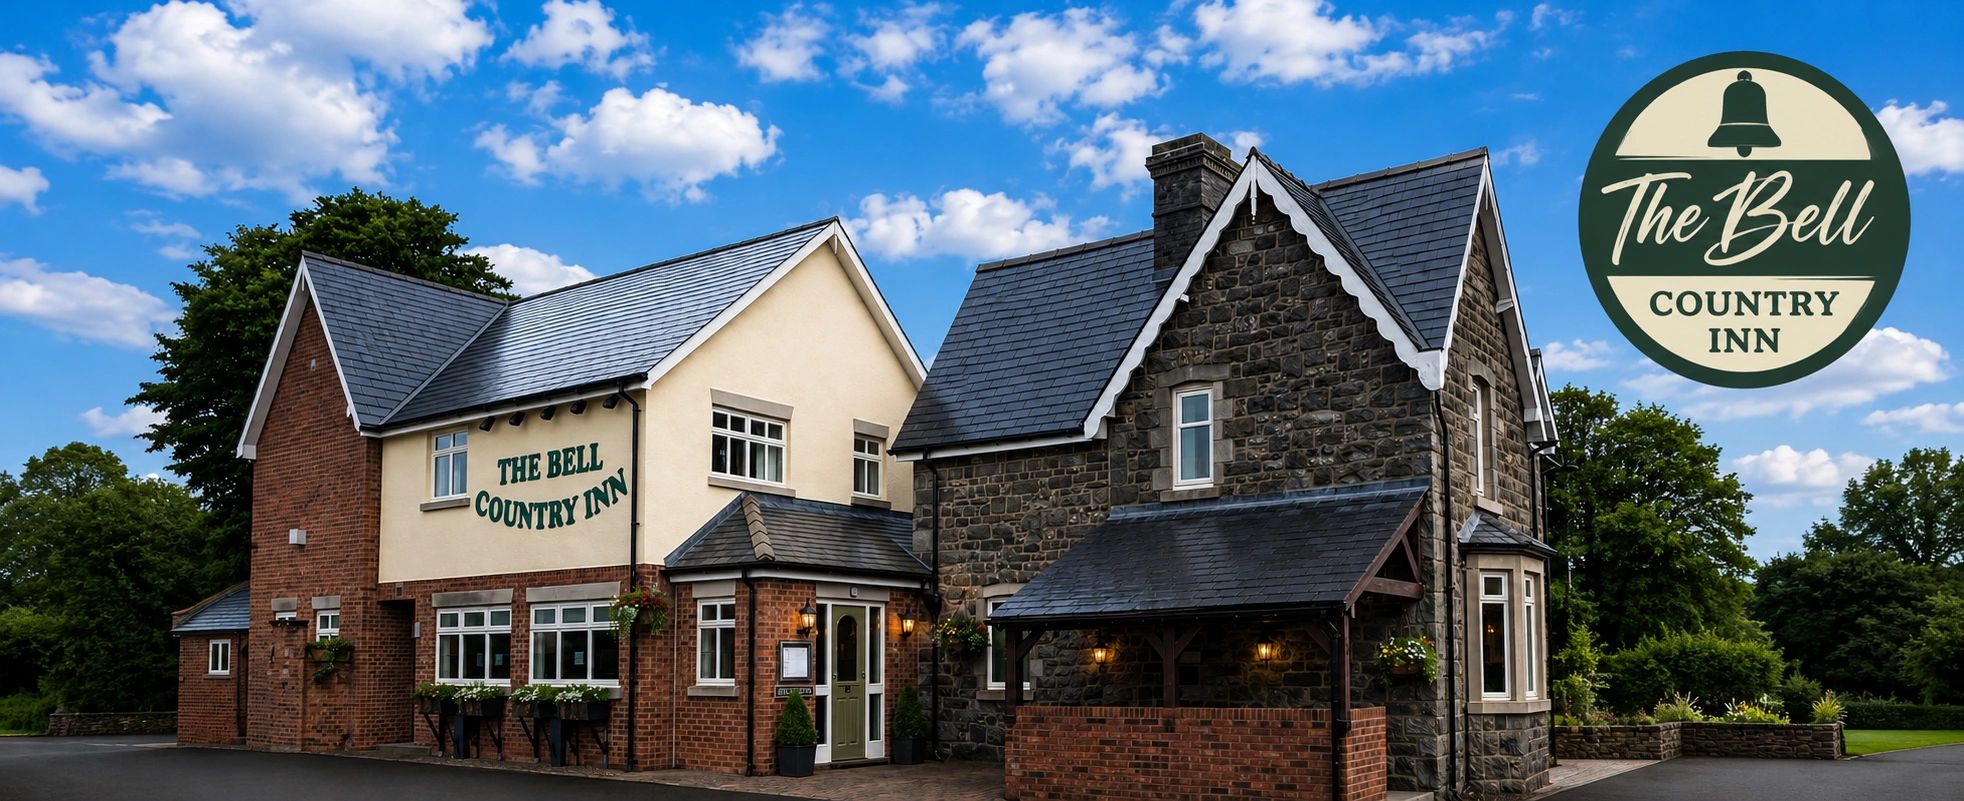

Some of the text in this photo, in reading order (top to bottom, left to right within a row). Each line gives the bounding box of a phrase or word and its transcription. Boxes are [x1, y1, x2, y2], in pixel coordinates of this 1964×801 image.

[497, 442, 603, 485] THE BELL
[475, 467, 628, 530] COUNTRY INN
